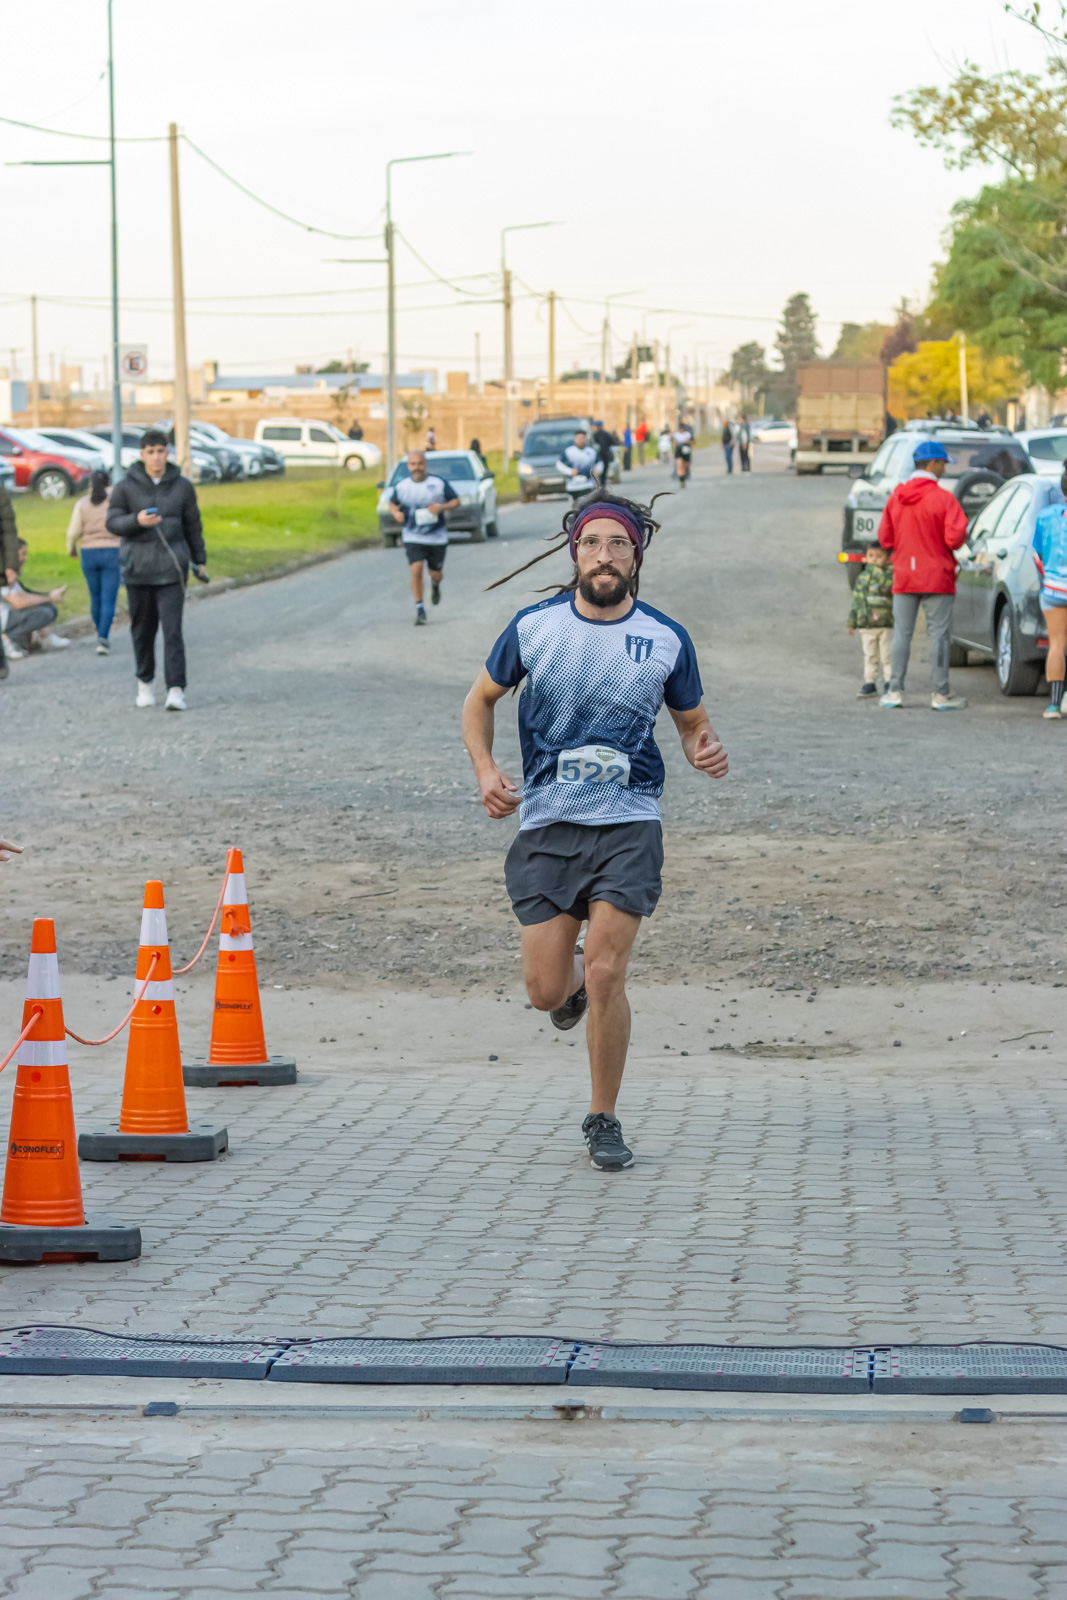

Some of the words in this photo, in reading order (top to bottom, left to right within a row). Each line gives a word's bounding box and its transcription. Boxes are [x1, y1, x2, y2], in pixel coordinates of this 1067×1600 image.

[856, 517, 874, 532] 80
[630, 637, 649, 646] SFC
[561, 760, 625, 784] 522
[17, 1145, 61, 1154] CONOFLEX
